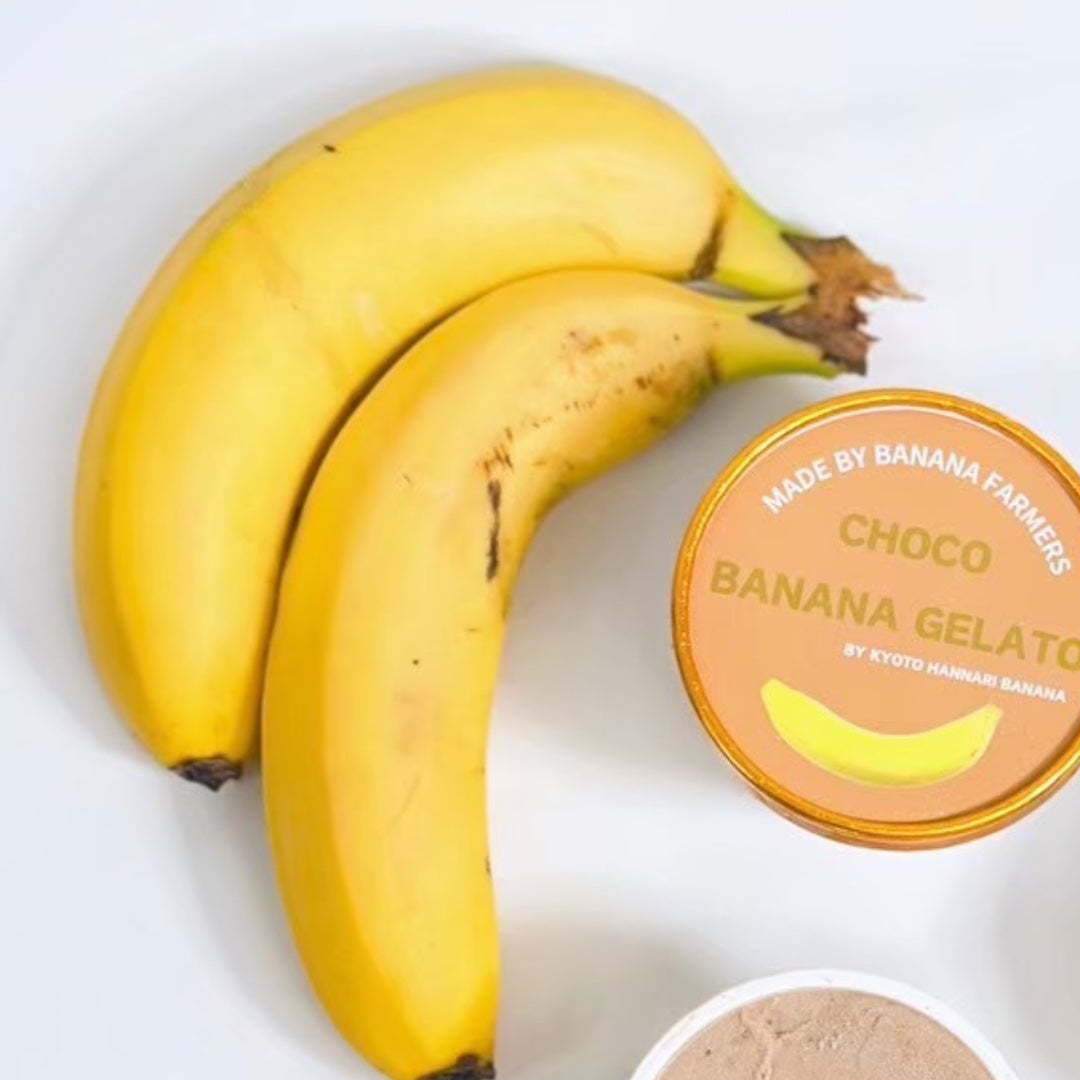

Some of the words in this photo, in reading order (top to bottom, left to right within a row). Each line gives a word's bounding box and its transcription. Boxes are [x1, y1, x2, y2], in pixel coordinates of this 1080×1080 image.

[762, 458, 832, 513] MADE
[835, 446, 867, 474] BY
[874, 444, 979, 484] BANANA
[982, 472, 1071, 576] FARMERS
[839, 513, 992, 573] CHOCO
[710, 560, 898, 631] BANANA
[843, 642, 867, 658] BY
[870, 649, 924, 672] KYOTO
[927, 661, 997, 687] HANNARI
[1000, 675, 1066, 702] BANANA
